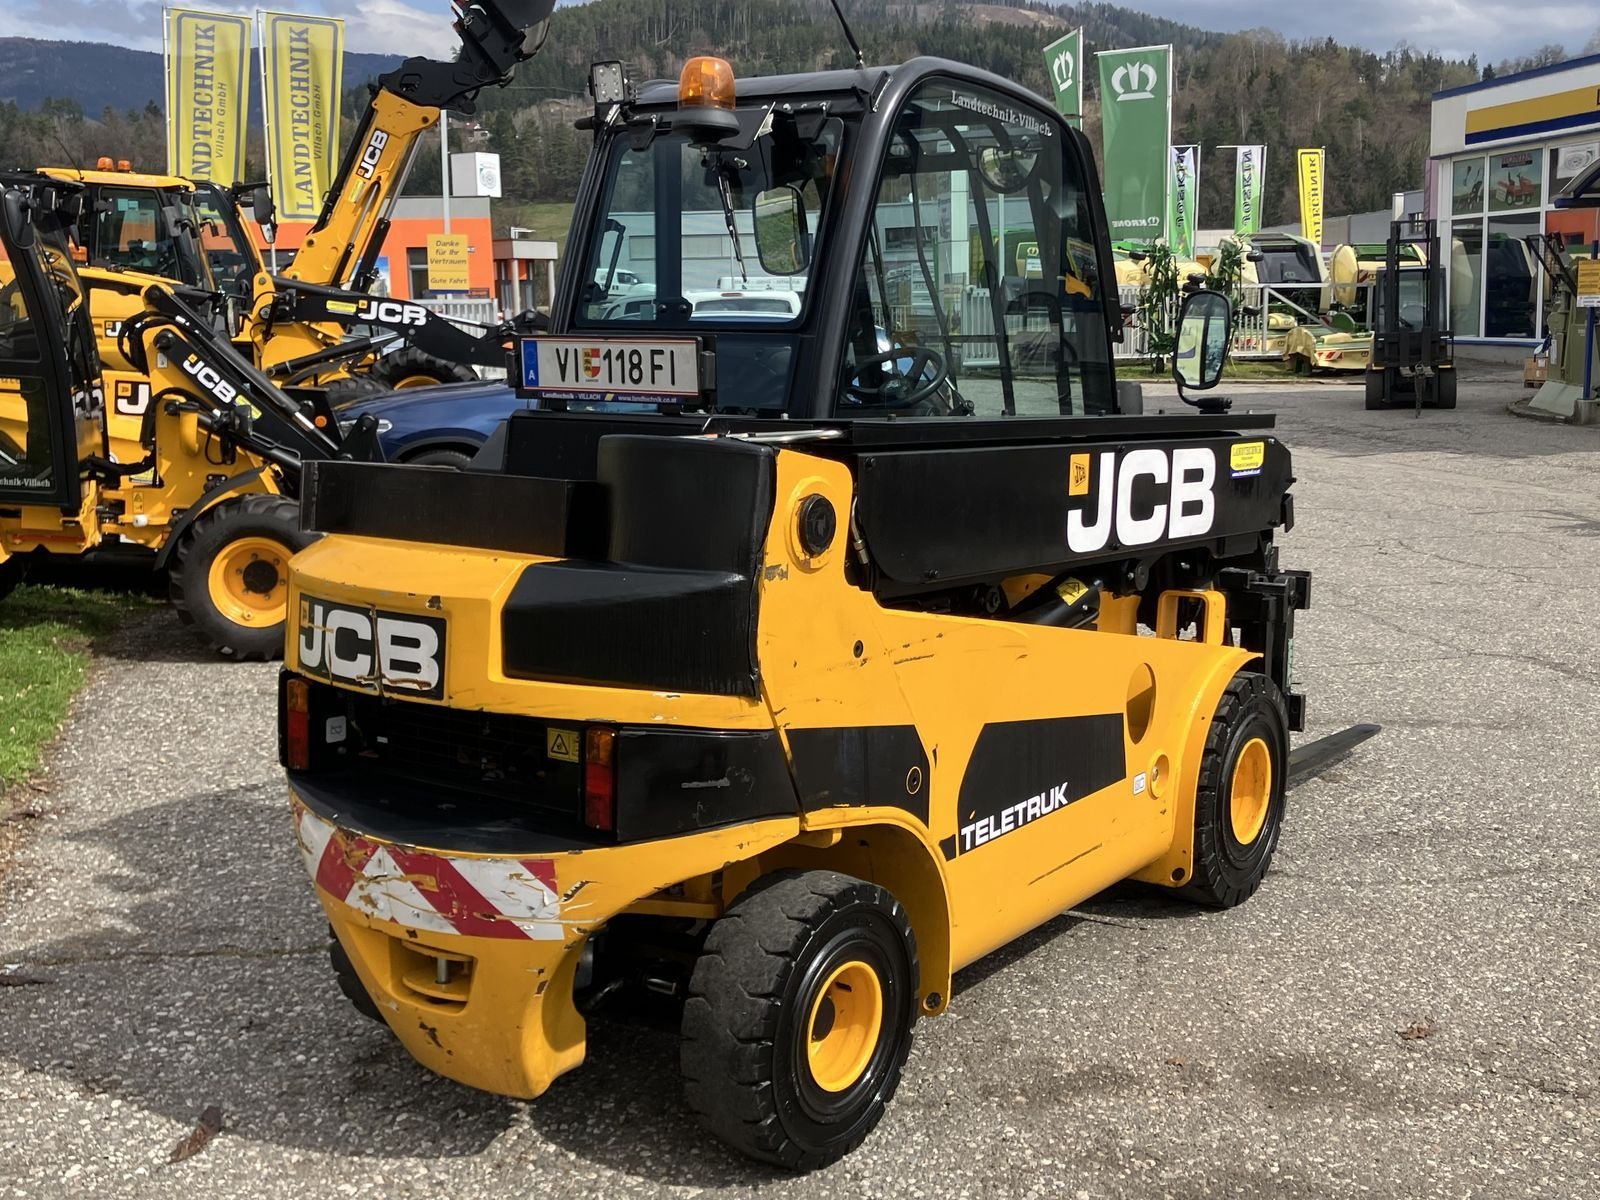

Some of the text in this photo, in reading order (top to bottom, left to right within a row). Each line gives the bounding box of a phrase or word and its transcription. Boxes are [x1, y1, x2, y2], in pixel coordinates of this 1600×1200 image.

[192, 24, 215, 180] NDTECHNIK
[216, 82, 227, 158] Villach GmbH
[290, 27, 315, 211] LANDTECHNIK
[952, 90, 1052, 136] Landtechnik-Villach
[314, 119, 322, 160] Villach
[359, 129, 389, 179] JCB
[435, 248, 447, 256] für
[358, 301, 427, 326] JCB
[182, 359, 237, 404] JCB
[528, 370, 536, 380] A
[556, 347, 675, 386] VI 118 FI
[1067, 448, 1216, 553] JCB
[300, 604, 439, 691] JCB
[961, 782, 1068, 850] TELETRUK
